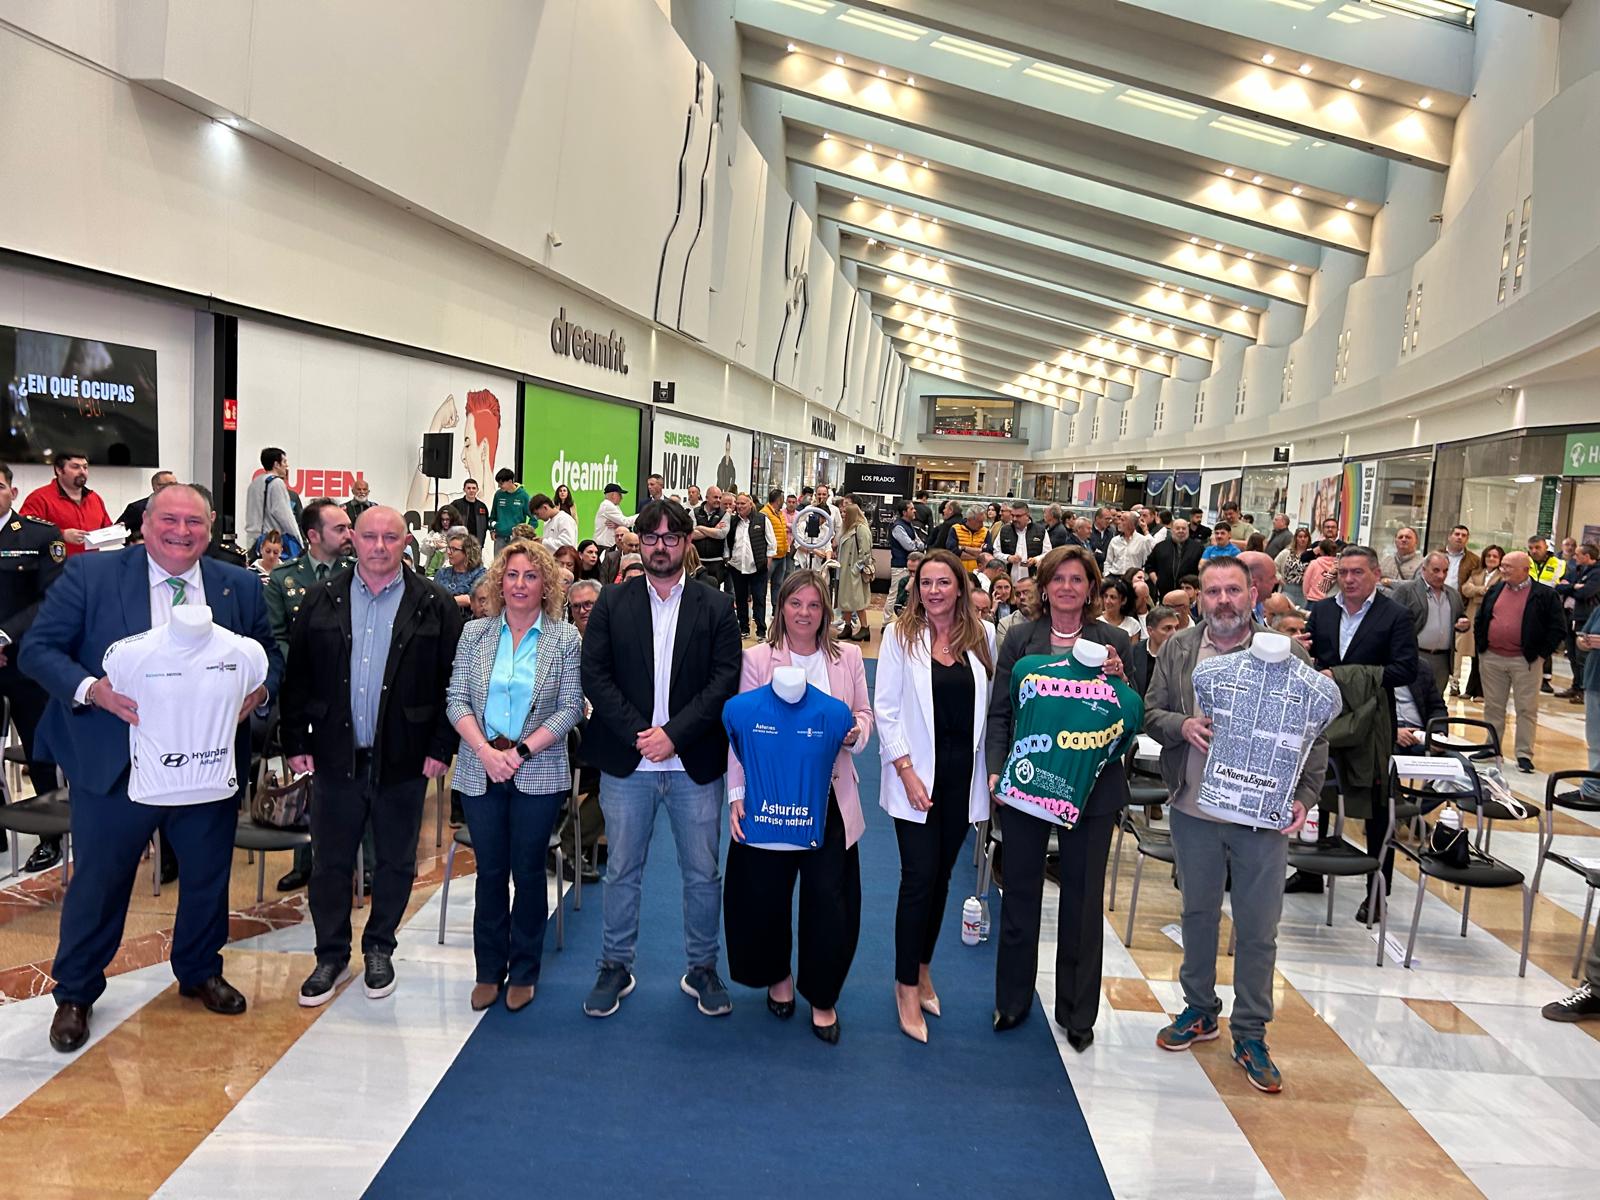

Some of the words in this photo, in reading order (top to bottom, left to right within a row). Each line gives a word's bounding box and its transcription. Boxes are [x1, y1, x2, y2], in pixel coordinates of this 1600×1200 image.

[19, 374, 47, 397] ¿EN
[50, 375, 79, 399] QUÉ
[81, 380, 135, 403] OCUPAS
[664, 431, 678, 445] SIN
[678, 433, 700, 449] PESAS
[252, 469, 364, 498] UEEN
[663, 452, 678, 489] NO
[680, 454, 700, 490] HAY
[761, 800, 808, 816] Asturias
